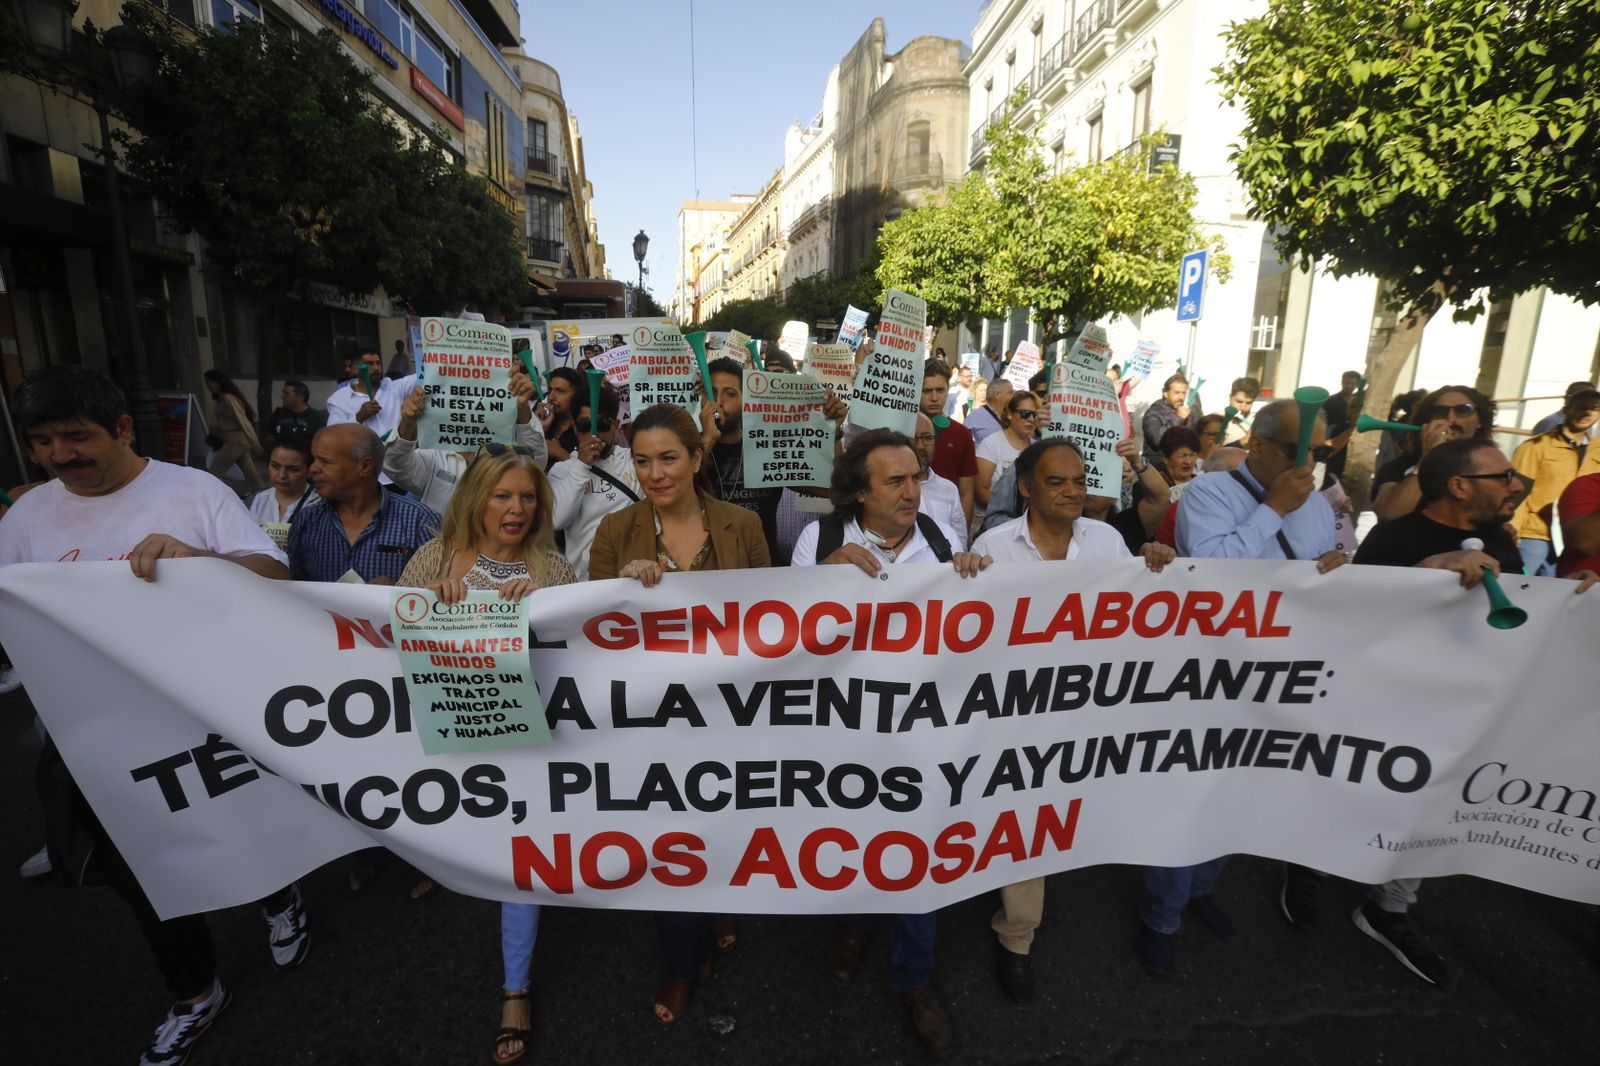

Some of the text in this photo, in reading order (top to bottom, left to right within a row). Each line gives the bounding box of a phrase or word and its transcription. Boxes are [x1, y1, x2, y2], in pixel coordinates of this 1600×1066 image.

[1182, 259, 1202, 297] P
[880, 334, 916, 352] UNIDOS
[630, 355, 691, 365] AMBULANT
[874, 353, 913, 371] SOMOS
[1078, 350, 1103, 362] CONTRA
[438, 366, 491, 379] UNIDOS
[648, 366, 690, 375] UNIDOS
[823, 369, 851, 377] UNIDOS
[867, 365, 916, 386] FAMILIAS,
[424, 384, 512, 399] SR. BELLIDO:
[635, 382, 694, 392] SR. BELLID
[863, 378, 916, 399] NO SOMOS
[642, 391, 700, 403] NI ESTÁ NI
[852, 388, 919, 414] DELINCUENTES
[431, 397, 504, 412] NI ESTÁ NI
[743, 402, 823, 413] AMBULANTE
[450, 413, 485, 424] SE LE
[763, 413, 810, 423] UNIDOS
[1062, 405, 1103, 420] UNIDOS
[439, 424, 495, 435] ESPERA.
[748, 428, 830, 439] SR. BELLIDO:
[1048, 422, 1120, 440] SR. BELLIDO:
[756, 436, 821, 449] NI ESTÁ NI
[1099, 442, 1112, 452] NI
[773, 450, 804, 459] SE LE
[1084, 451, 1095, 461] LE
[763, 462, 814, 471] ESPERA.
[762, 470, 815, 482] MÓJESE.
[432, 600, 520, 615] Comacor
[429, 615, 465, 623] Asociación
[582, 600, 994, 658] GENOCIDIO
[1007, 590, 1292, 646] LABORAL
[401, 637, 523, 653] AMBULANTES
[430, 655, 496, 669] UNIDOS
[412, 673, 523, 685] EXIGIMOS UN
[442, 687, 500, 699] TRATO
[610, 680, 707, 729] LA
[717, 677, 948, 733] VENTA
[954, 658, 1336, 726] AMBULANTE:
[431, 699, 522, 712] MUNICIPAL
[454, 713, 506, 725] JUSTO
[438, 723, 529, 738] Y HUMANO
[547, 760, 923, 813] PLACEROS
[937, 754, 981, 808] Y
[981, 728, 1432, 800] AYUNTAMIENTO
[1461, 761, 1600, 822] Com
[1448, 808, 1600, 843] Asociación de C
[511, 798, 1083, 895] NOS ACOSAN
[1367, 832, 1459, 853] Autónomos
[1461, 829, 1579, 865] Ambulantes
